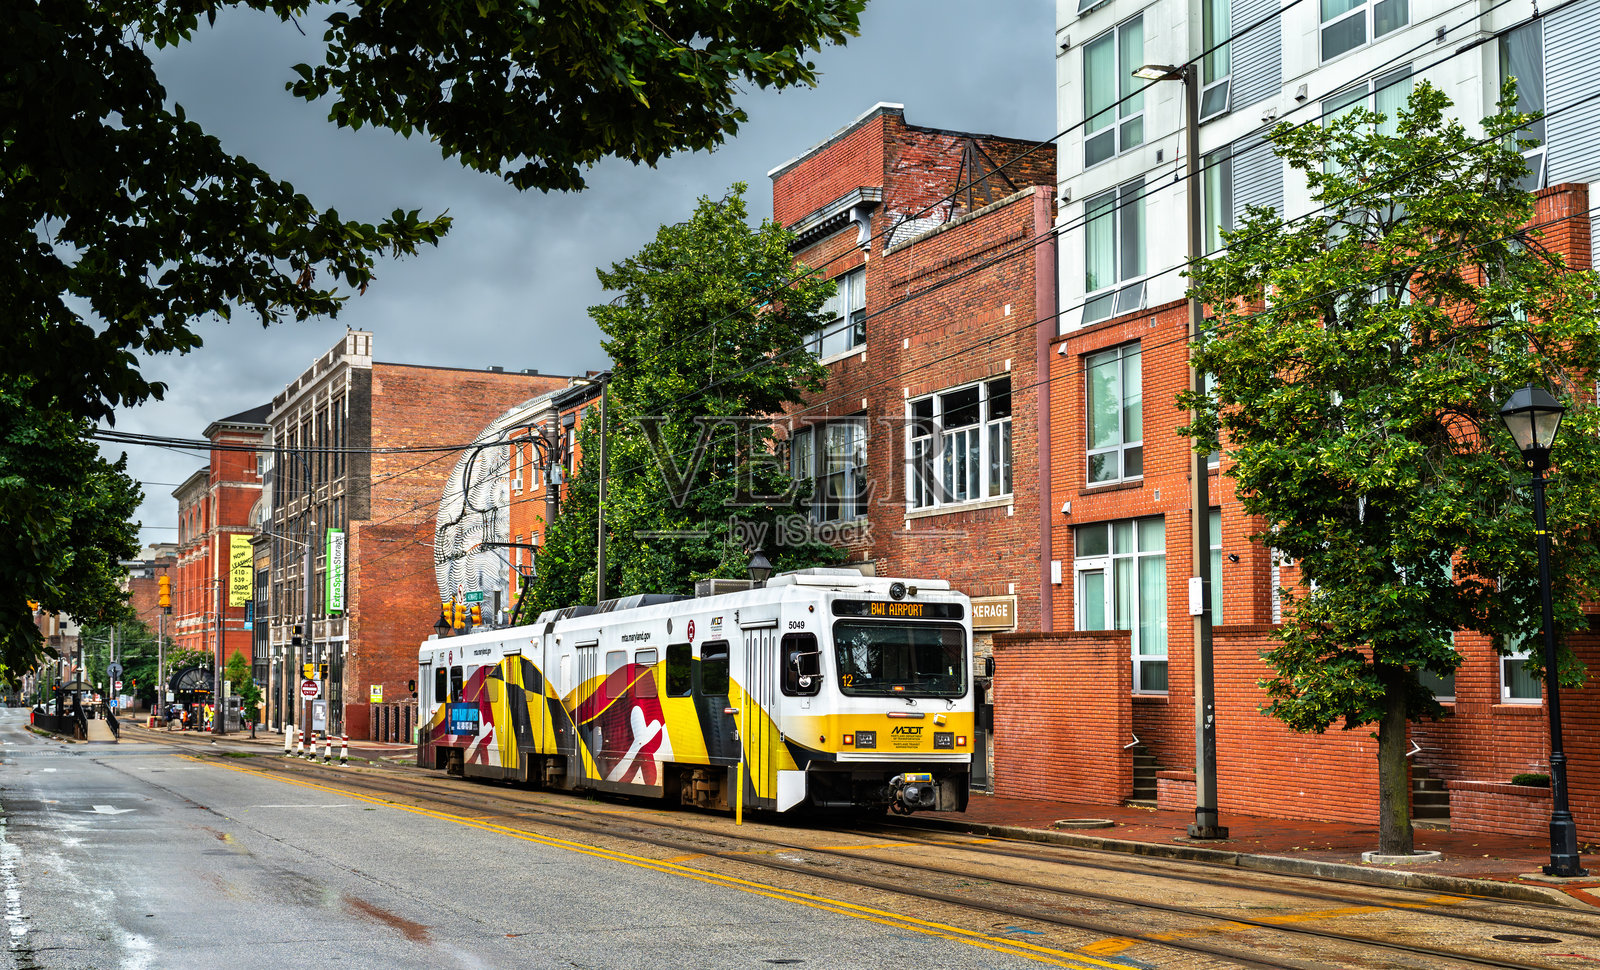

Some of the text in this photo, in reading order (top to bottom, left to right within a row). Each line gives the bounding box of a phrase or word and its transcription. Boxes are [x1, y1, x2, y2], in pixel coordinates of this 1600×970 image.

[233, 551, 246, 560] NOW
[871, 602, 924, 616] BWI AIRPORT
[788, 621, 805, 630] 5049
[621, 630, 651, 643] mta.maryland.gov
[842, 674, 854, 687] 12
